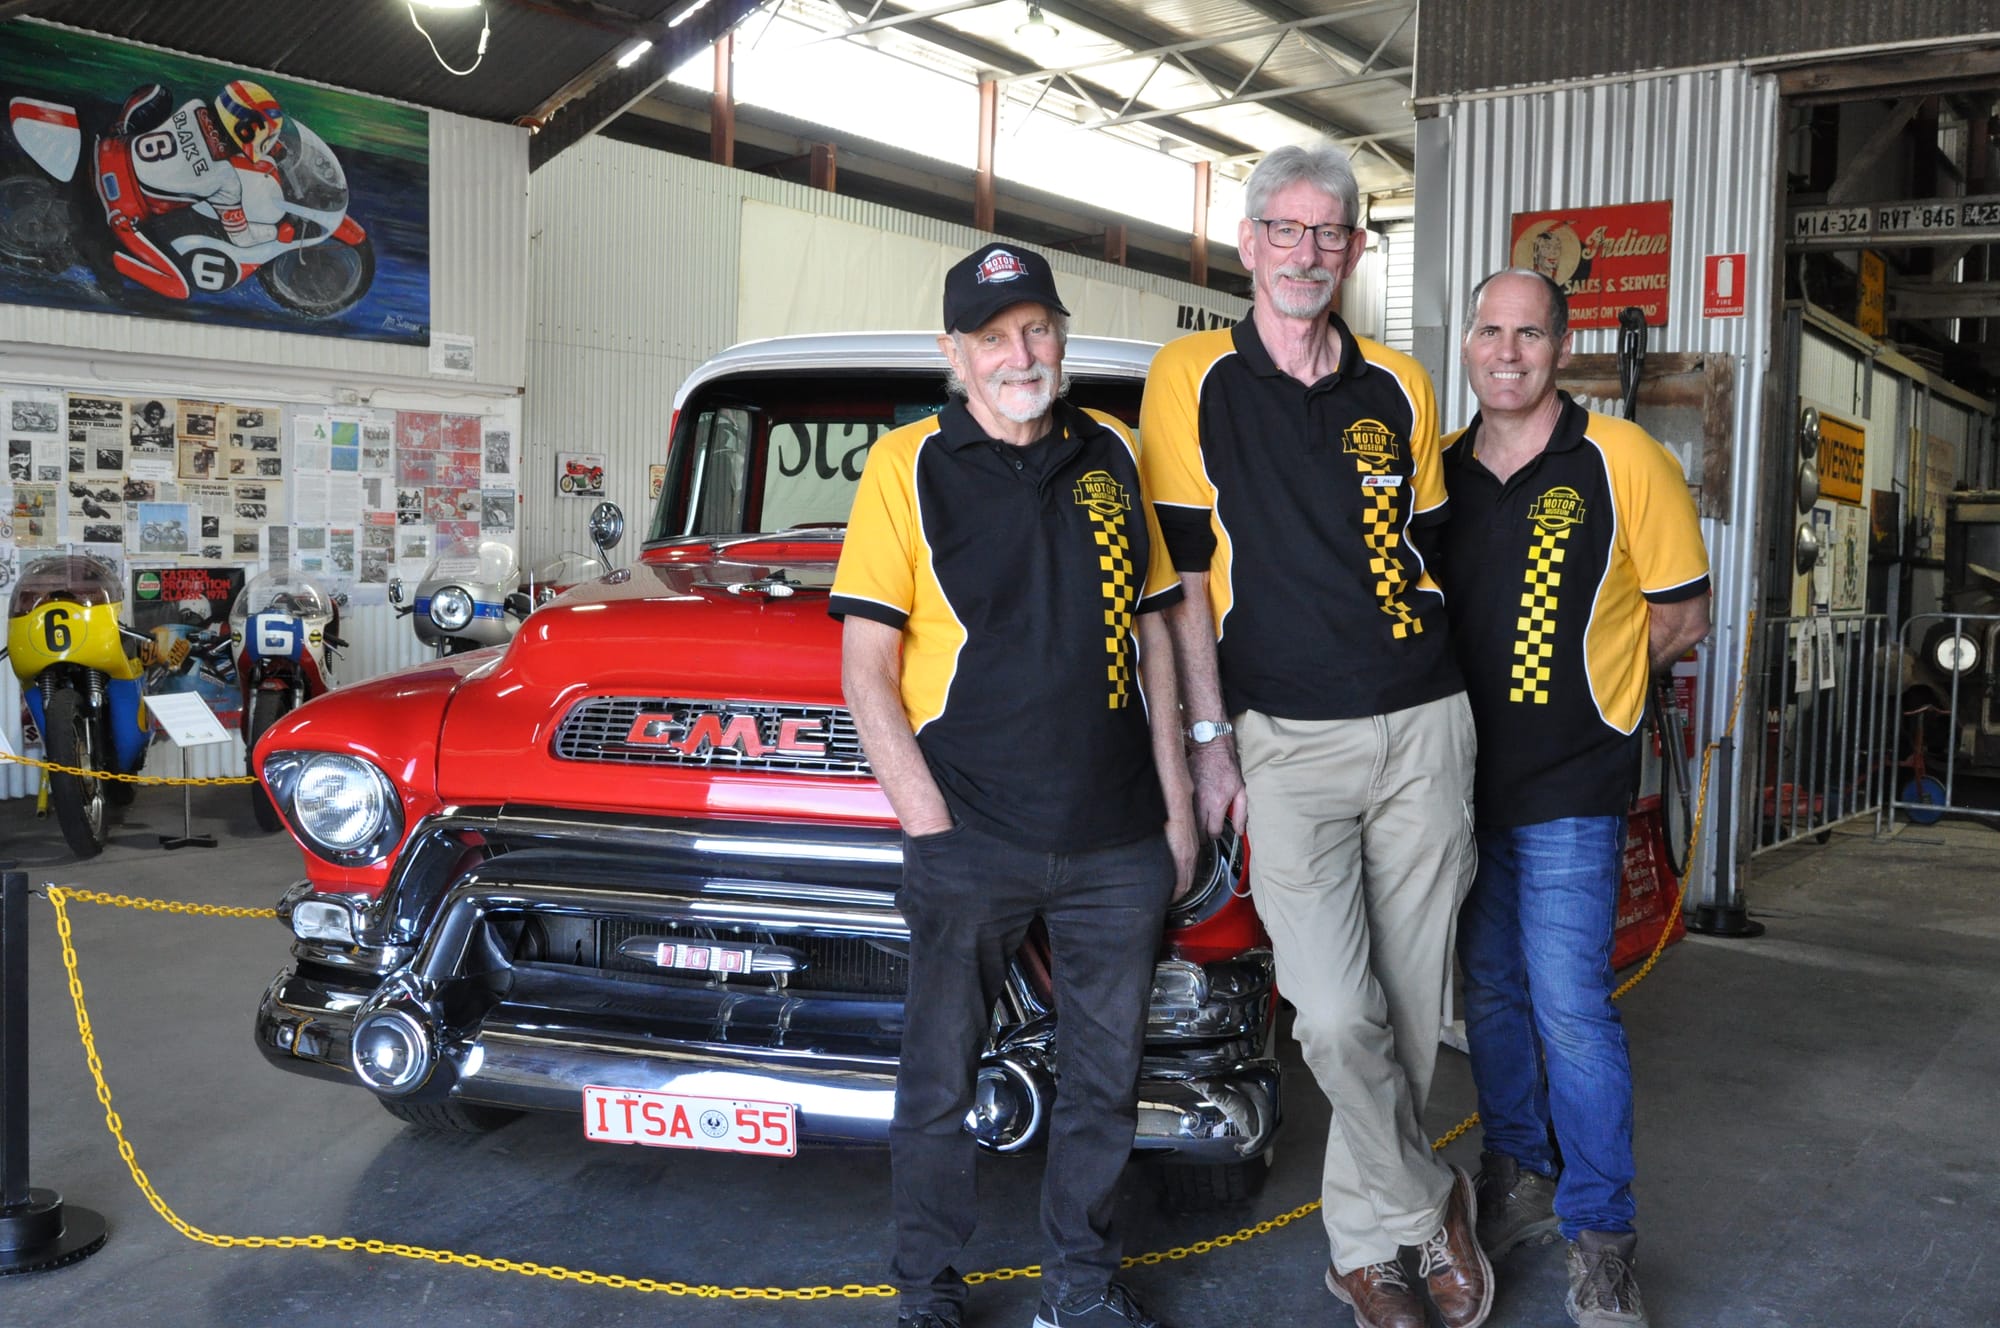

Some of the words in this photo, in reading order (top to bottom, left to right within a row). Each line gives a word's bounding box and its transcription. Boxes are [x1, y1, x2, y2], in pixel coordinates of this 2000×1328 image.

[137, 132, 177, 162] 6
[172, 110, 209, 176] BLAKE
[1582, 226, 1668, 260] Indian
[191, 253, 226, 291] 6
[985, 256, 1015, 268] MOTOR
[1564, 279, 1600, 295] SALES
[1605, 278, 1616, 292] &
[1620, 273, 1667, 291] SERVICE
[1353, 432, 1387, 445] MOTOR
[1358, 443, 1385, 452] MUSEUM
[1819, 436, 1865, 484] OVERSIZE
[1085, 483, 1117, 497] MOTOR
[1543, 498, 1576, 511] MOTOR
[162, 570, 208, 580] CASTROL
[162, 589, 203, 600] CLASSIC
[44, 608, 72, 652] 6
[257, 614, 294, 655] 6
[625, 712, 830, 758] GMC
[596, 1097, 694, 1139] ITSA
[735, 1108, 787, 1146] 55
